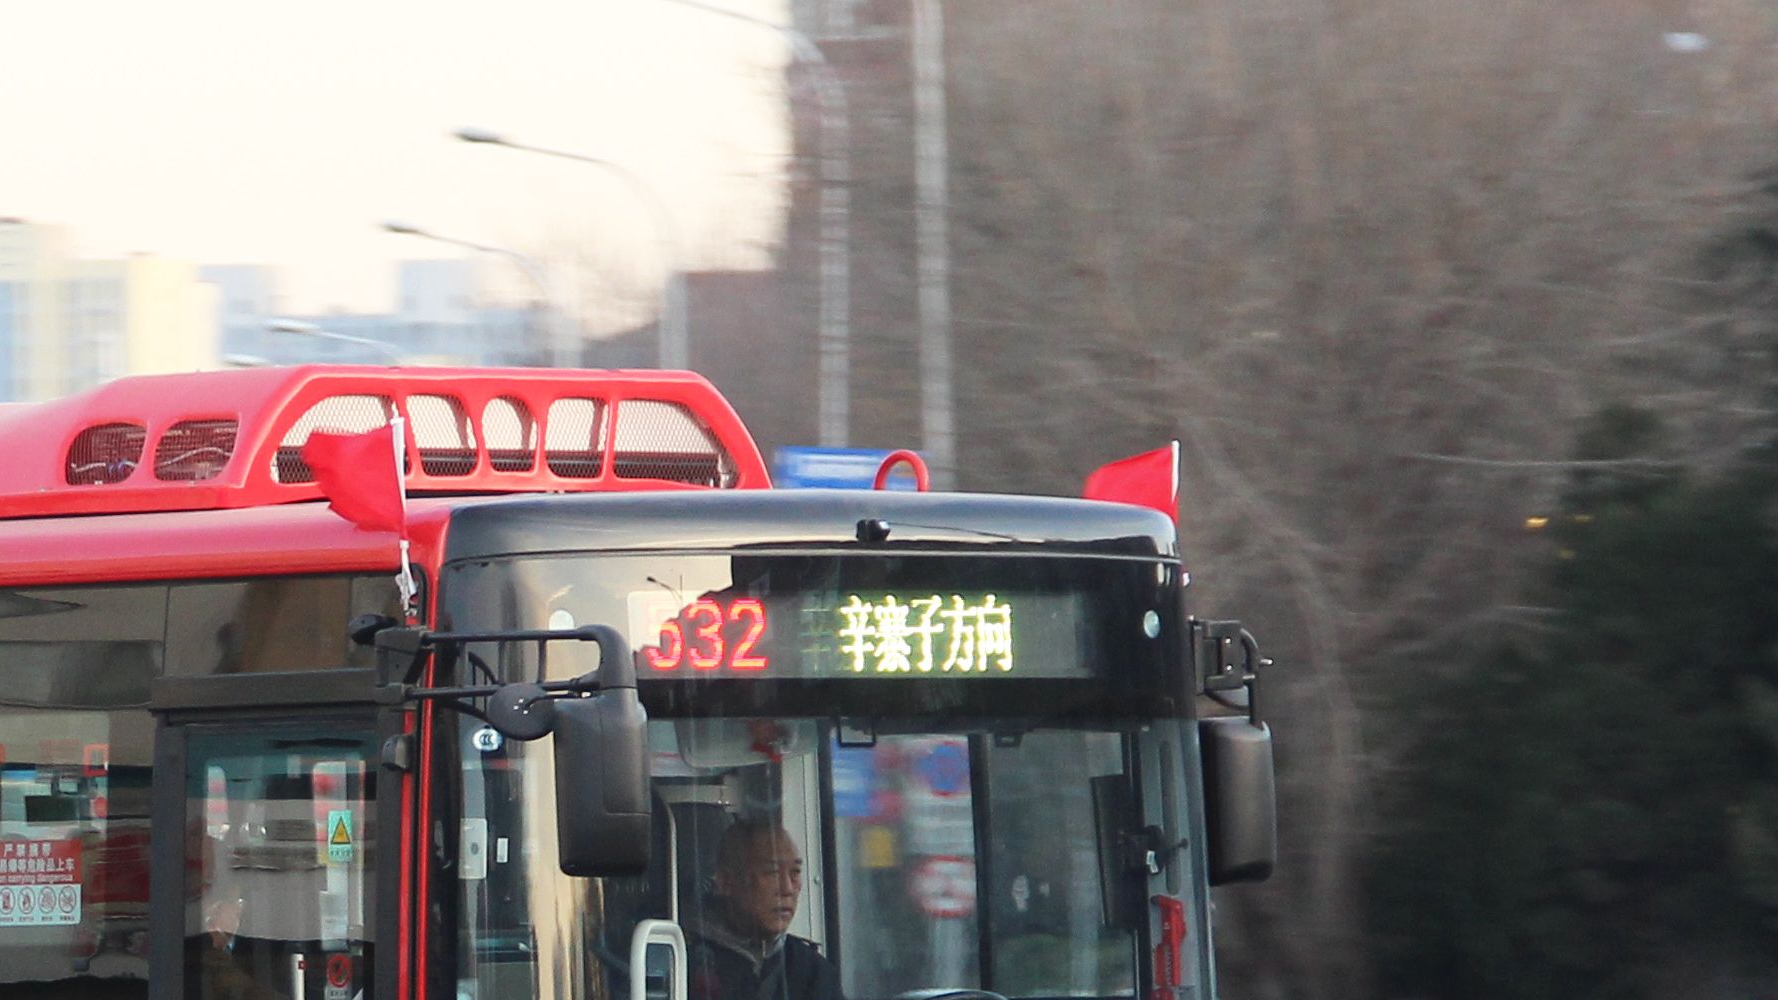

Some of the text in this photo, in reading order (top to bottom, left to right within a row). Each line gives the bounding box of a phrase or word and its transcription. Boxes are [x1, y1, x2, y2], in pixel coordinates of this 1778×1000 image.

[644, 594, 1015, 673] 532 辛寨子方向
